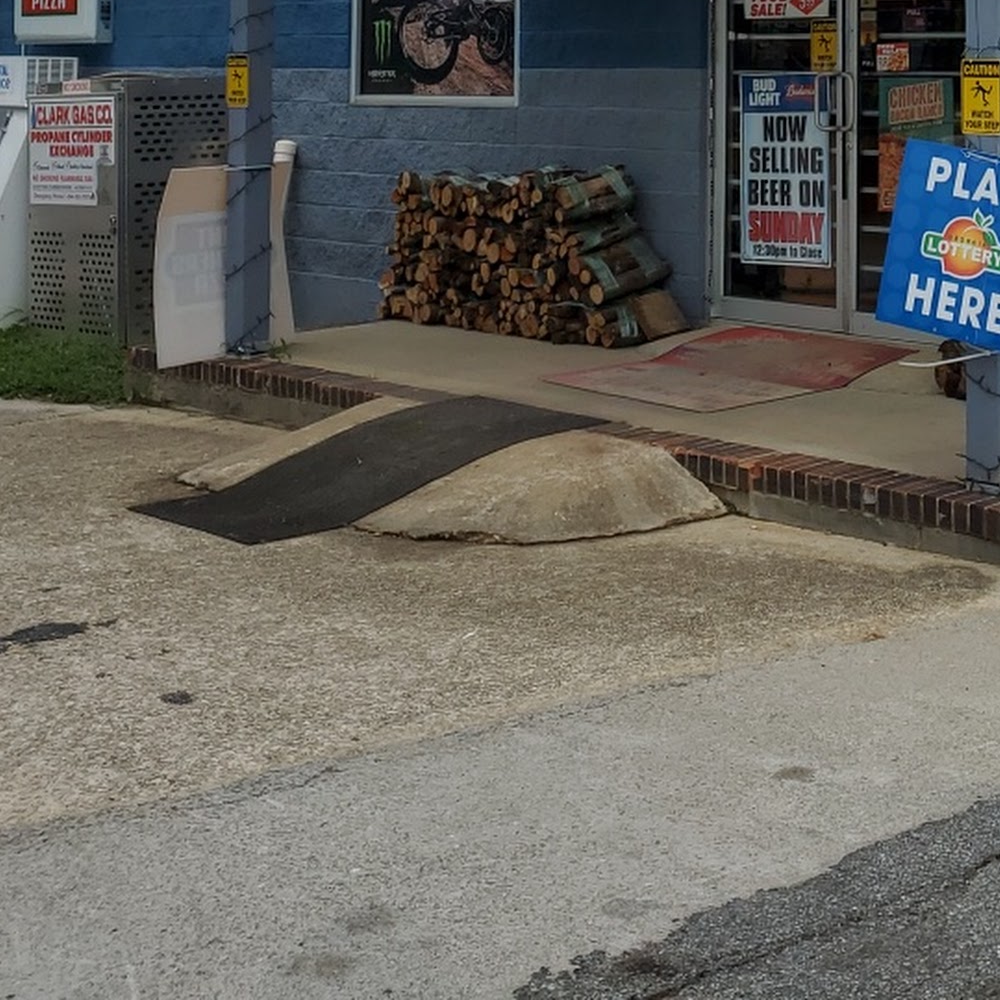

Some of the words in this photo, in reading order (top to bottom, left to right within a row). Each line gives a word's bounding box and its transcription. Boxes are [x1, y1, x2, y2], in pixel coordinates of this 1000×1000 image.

[750, 3, 787, 17] SALE!
[963, 63, 1000, 76] CAUTION
[752, 78, 777, 92] BUD
[748, 91, 781, 107] LIGHT
[890, 82, 942, 109] CHICKEN
[37, 105, 71, 125] CLARK
[72, 104, 95, 125] GAS
[31, 131, 70, 143] PROPANE
[71, 130, 113, 143] CYLINDER
[763, 115, 807, 142] NOW
[49, 145, 94, 157] EXCHANGE
[749, 146, 824, 174] SELLING
[748, 179, 791, 207] BEER
[799, 180, 825, 207] ON
[748, 211, 825, 244] SUNDAY
